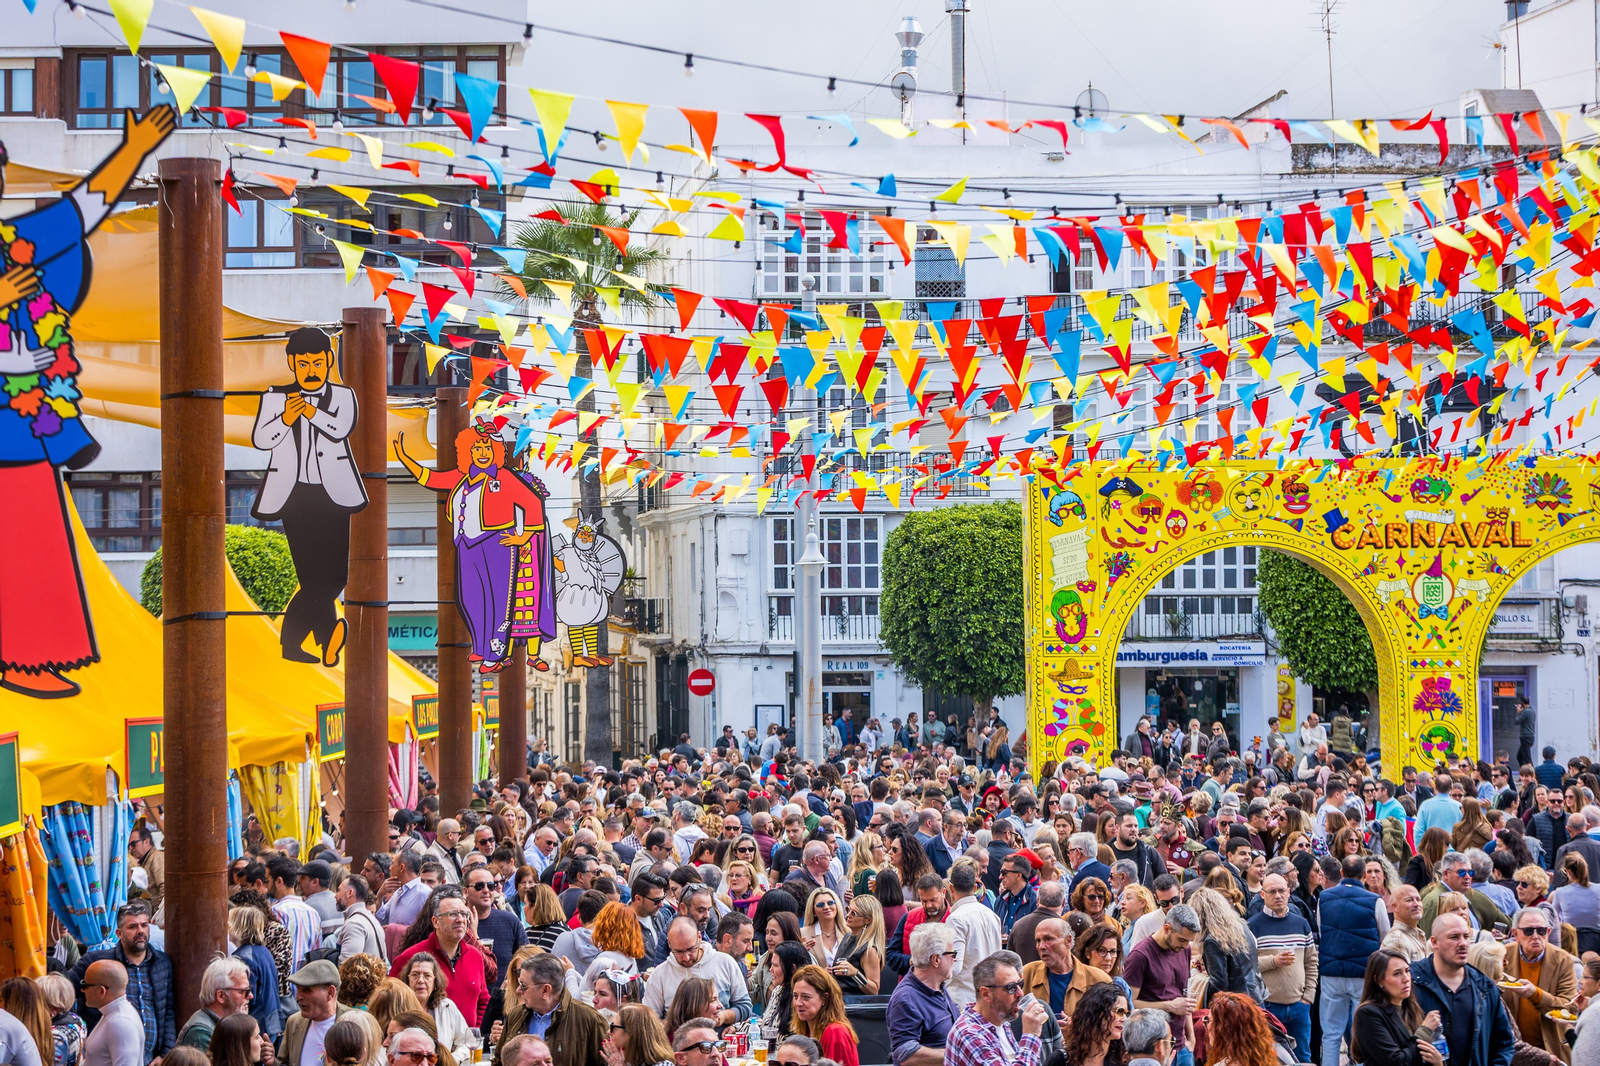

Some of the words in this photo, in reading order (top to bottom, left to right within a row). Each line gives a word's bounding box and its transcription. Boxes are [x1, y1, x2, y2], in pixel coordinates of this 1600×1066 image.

[1331, 521, 1533, 550] CARNAVAL
[1520, 615, 1534, 623] S.L.
[1116, 649, 1208, 663] amburguesía
[827, 660, 854, 672] REAL
[856, 661, 869, 670] 109
